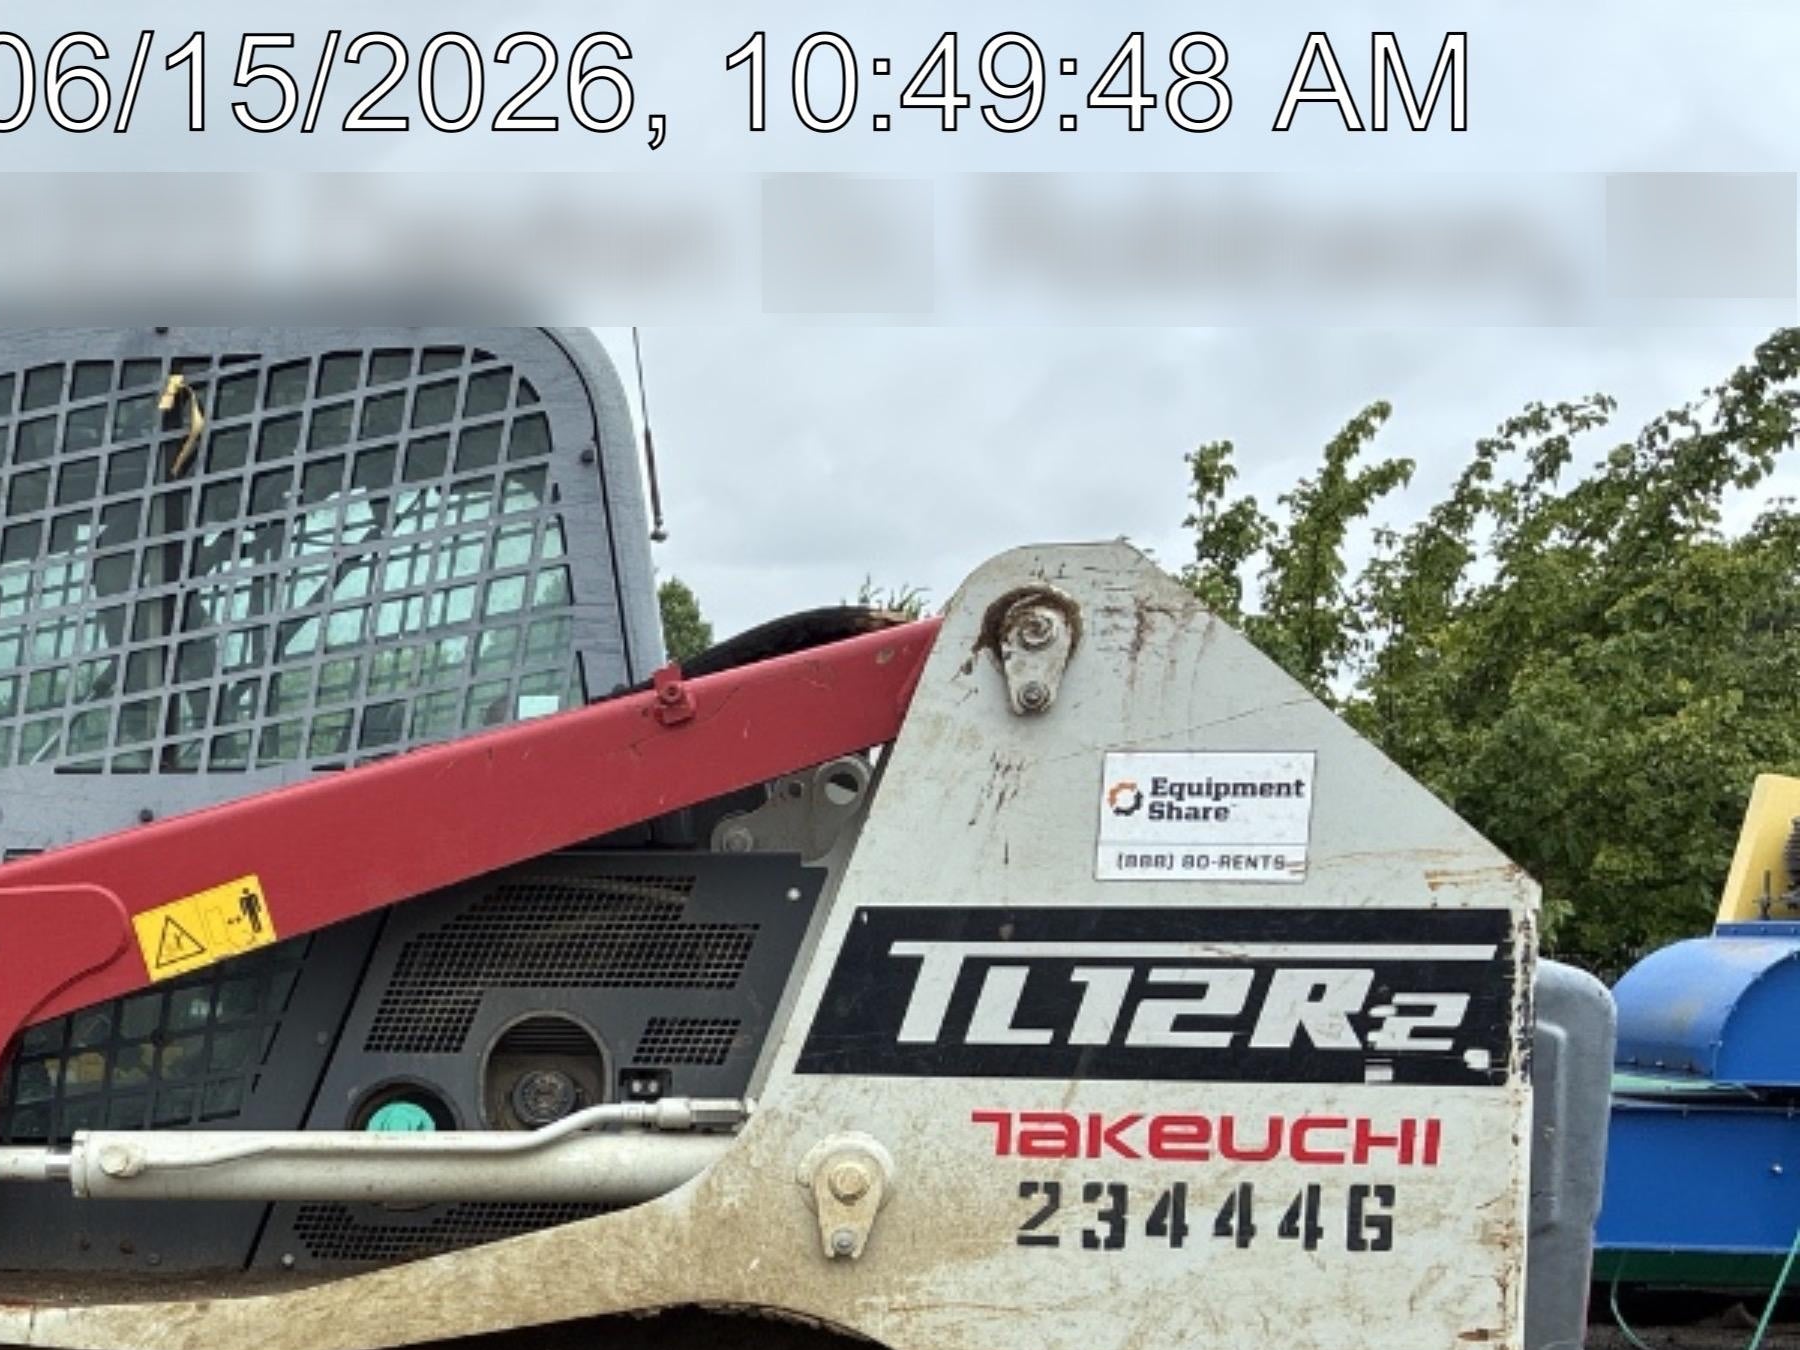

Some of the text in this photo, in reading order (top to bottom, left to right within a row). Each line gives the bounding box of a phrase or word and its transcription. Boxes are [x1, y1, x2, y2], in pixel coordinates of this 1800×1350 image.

[1149, 775, 1307, 801] Equipment
[1148, 801, 1231, 822] Share
[1016, 1181, 1397, 1253] 234446
